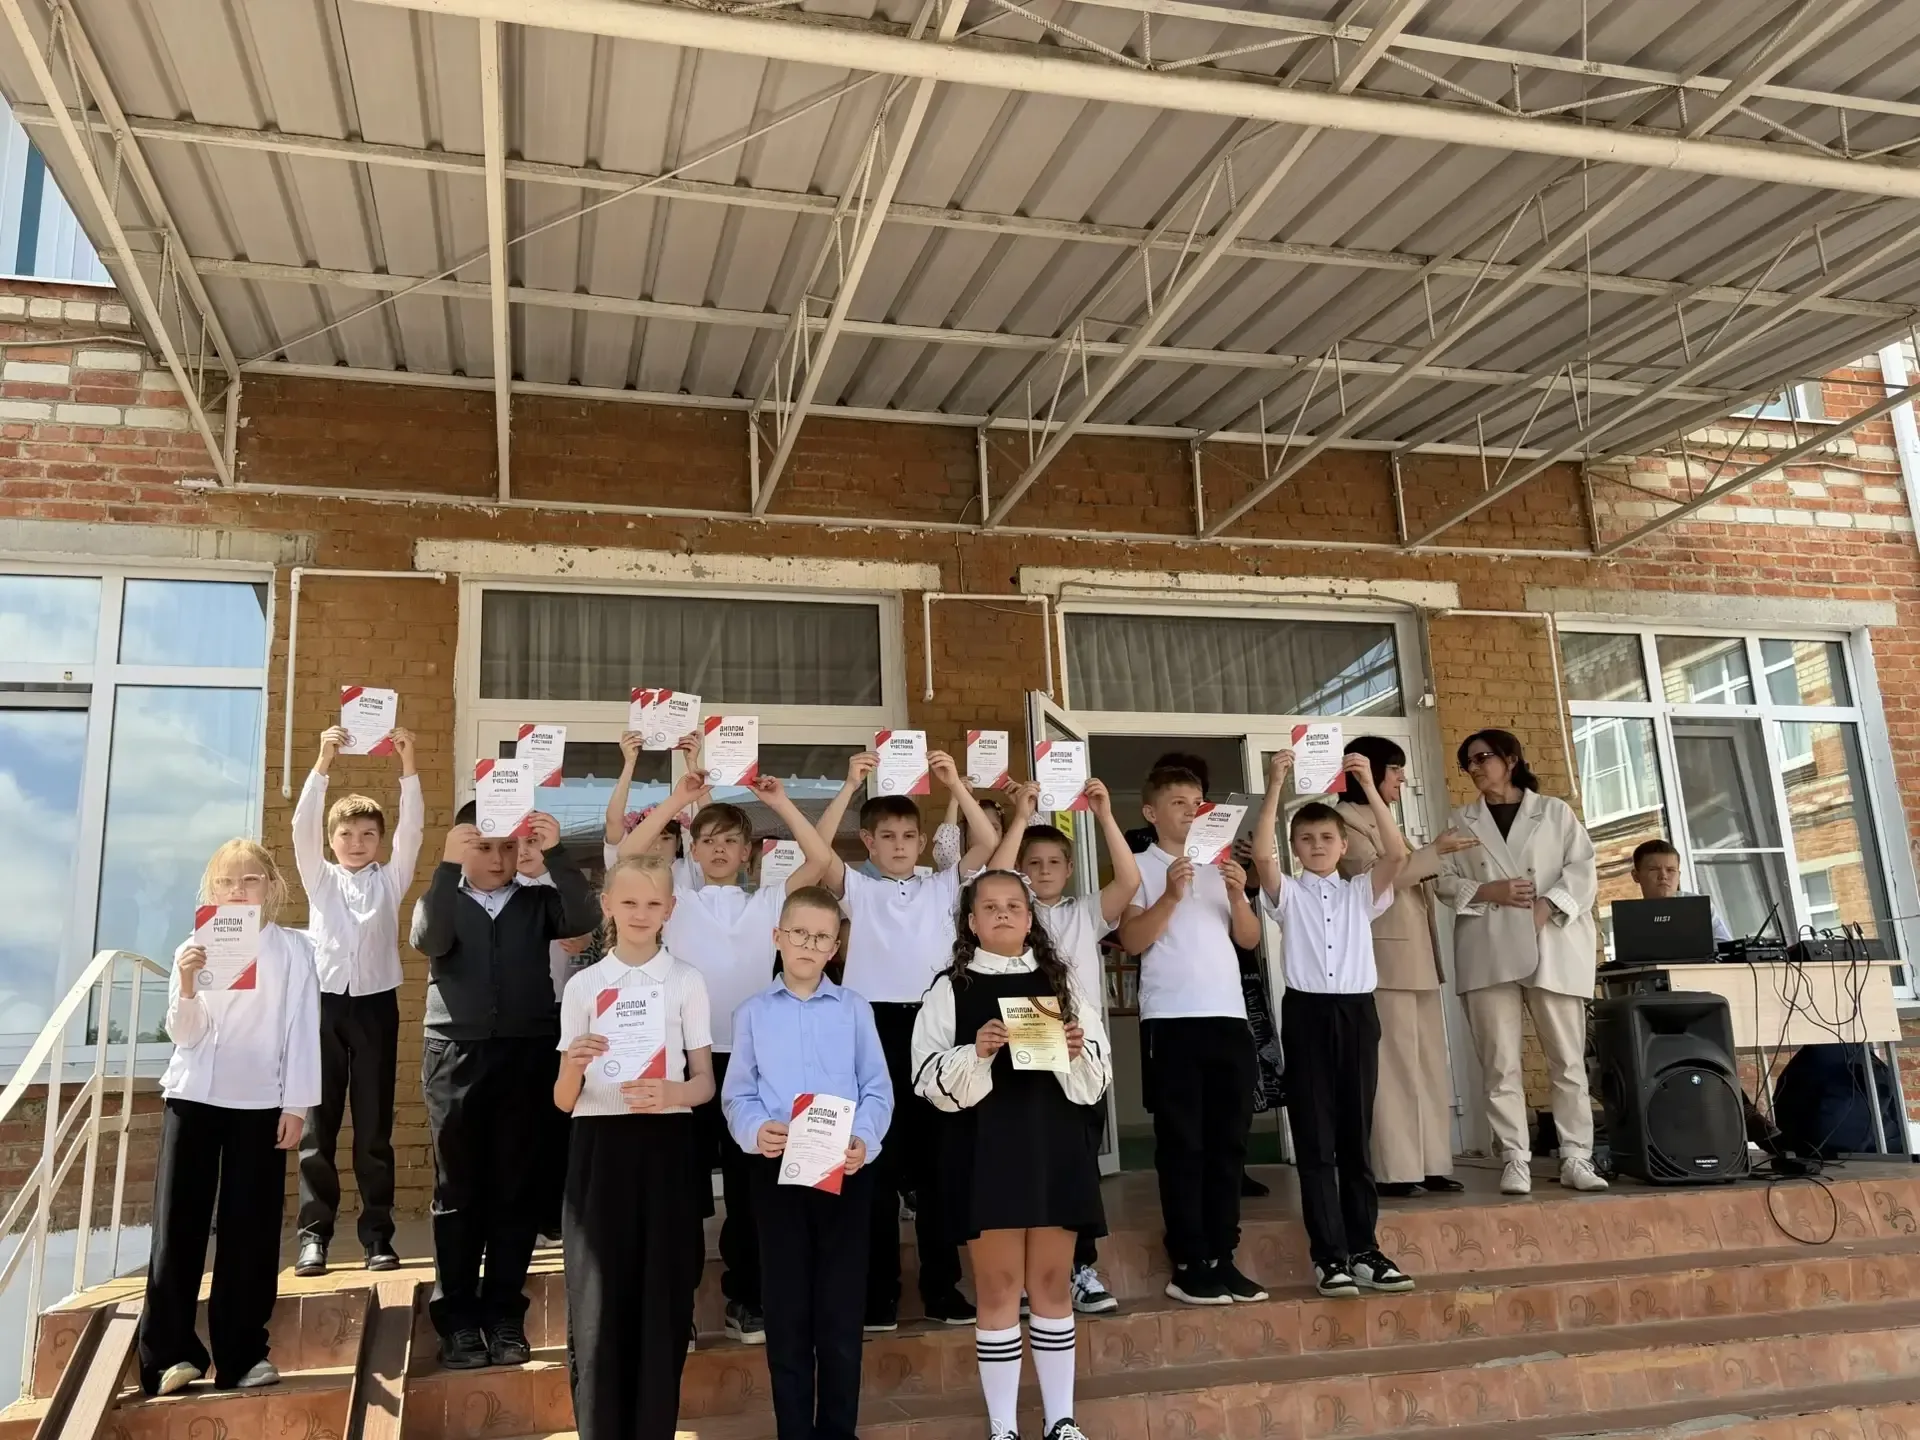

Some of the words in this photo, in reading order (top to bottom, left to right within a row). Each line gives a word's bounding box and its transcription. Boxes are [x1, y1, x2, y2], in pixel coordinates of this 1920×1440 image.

[669, 699, 689, 707] ДИПЛОМ
[492, 770, 519, 778] ДИПЛОМ
[213, 917, 243, 926] ДИПЛОМ
[615, 1000, 647, 1011] ДИПЛОМ
[615, 1008, 647, 1018] УЧАСТНИКА
[807, 1107, 838, 1119] ДИПЛОМ
[807, 1116, 836, 1127] УЧАСТНИКА
